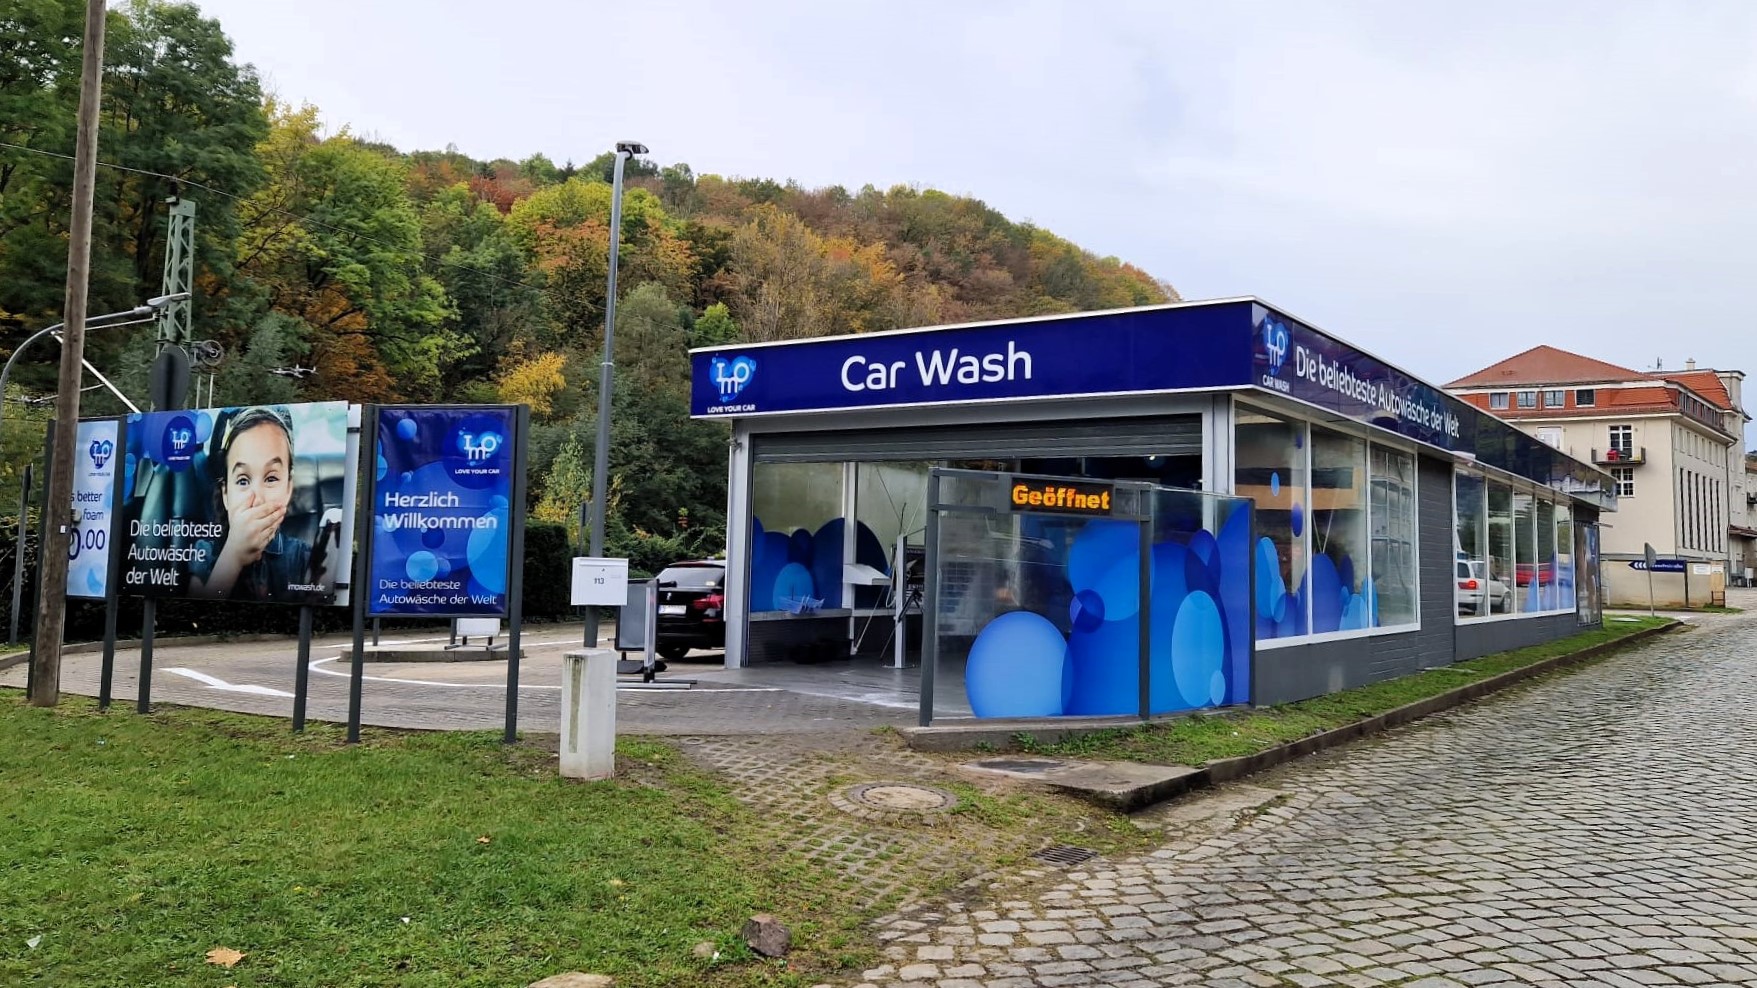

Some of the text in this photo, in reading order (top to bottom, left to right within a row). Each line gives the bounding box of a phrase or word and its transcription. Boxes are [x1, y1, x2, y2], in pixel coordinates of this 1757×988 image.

[840, 340, 1032, 392] Car Wash
[1262, 374, 1290, 393] CAR WASH
[1296, 346, 1460, 438] Die beliebteste Autowäsche der Welt
[77, 490, 103, 503] better
[385, 491, 459, 507] Herzlich
[1012, 484, 1110, 510] Geöffnet
[82, 508, 104, 521] foam
[384, 512, 498, 529] Willkommen
[130, 519, 222, 538] Die beliebteste
[127, 543, 206, 562] Autowäsche
[126, 568, 180, 586] der Welt
[379, 579, 461, 590] Die beliebteste
[379, 594, 497, 605] Autowäsche der Welt
